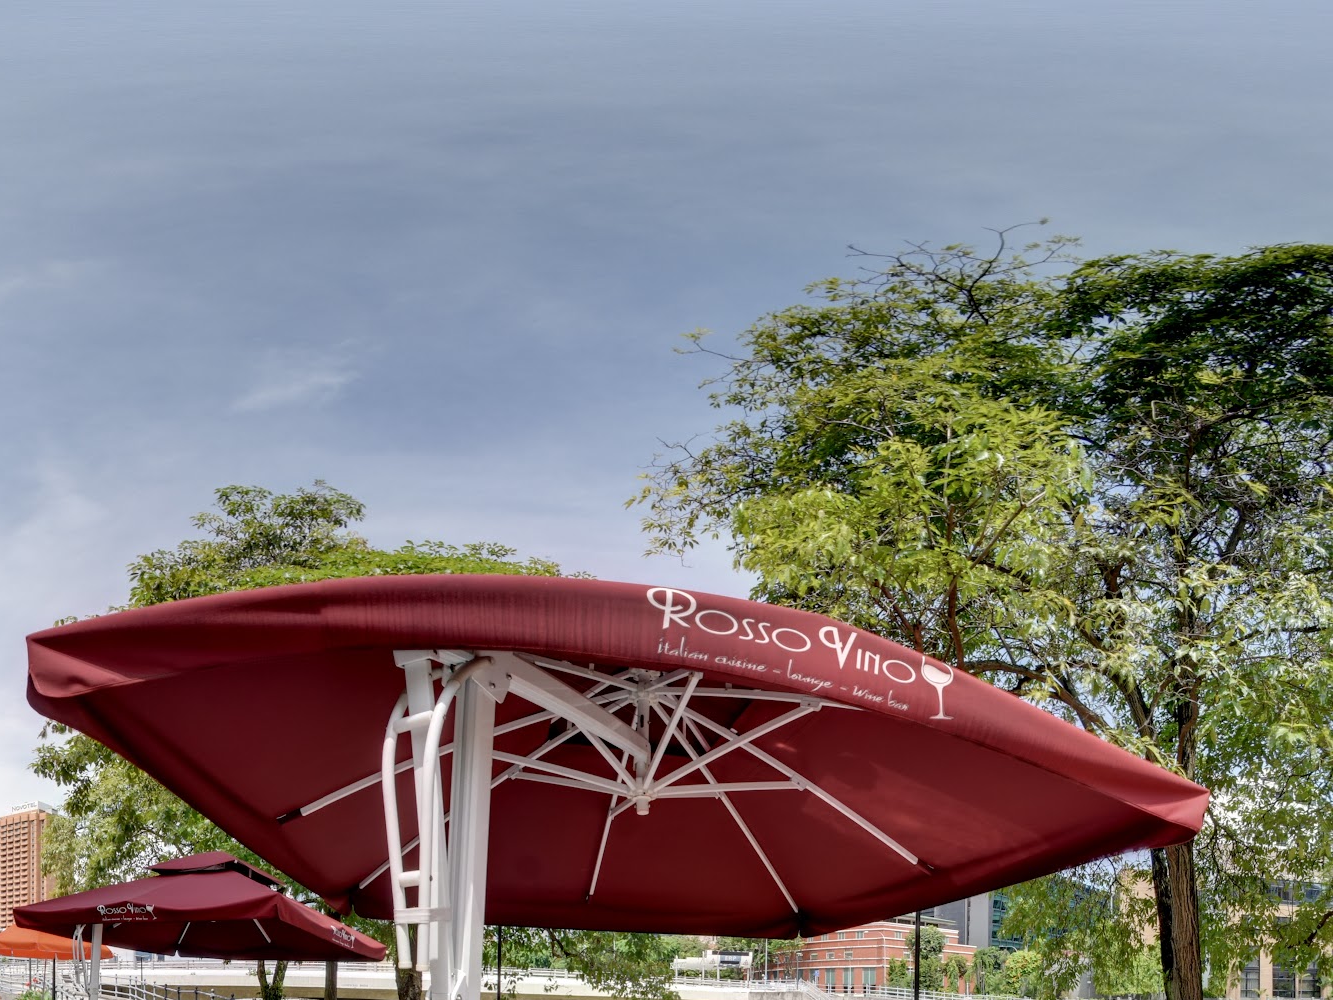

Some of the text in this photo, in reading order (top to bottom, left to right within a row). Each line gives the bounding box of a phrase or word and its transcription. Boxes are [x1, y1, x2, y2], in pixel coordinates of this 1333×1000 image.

[657, 637, 709, 661] italian
[714, 655, 767, 673] cuisine
[787, 659, 833, 693] lounge
[888, 690, 910, 712] bar
